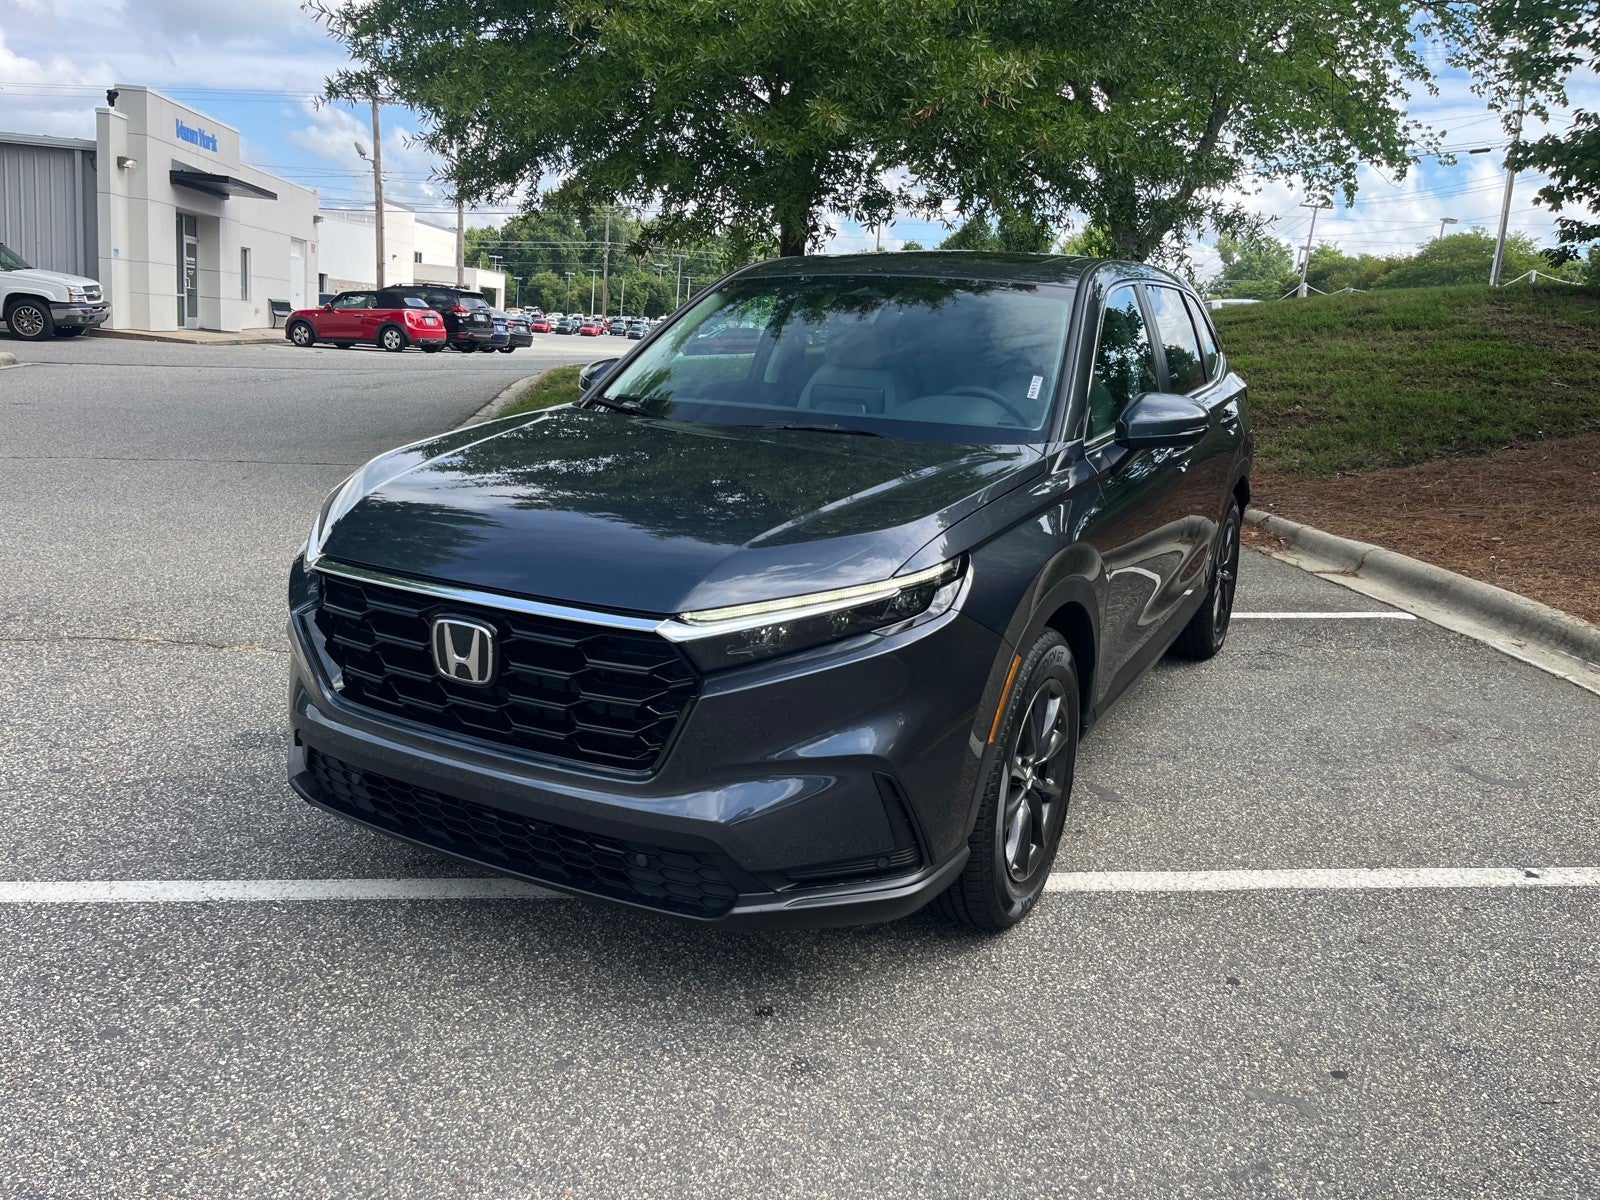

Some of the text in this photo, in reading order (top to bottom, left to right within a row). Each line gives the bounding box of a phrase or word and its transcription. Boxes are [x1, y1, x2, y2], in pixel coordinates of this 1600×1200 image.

[175, 118, 218, 153] Vann York
[444, 622, 480, 681] H
